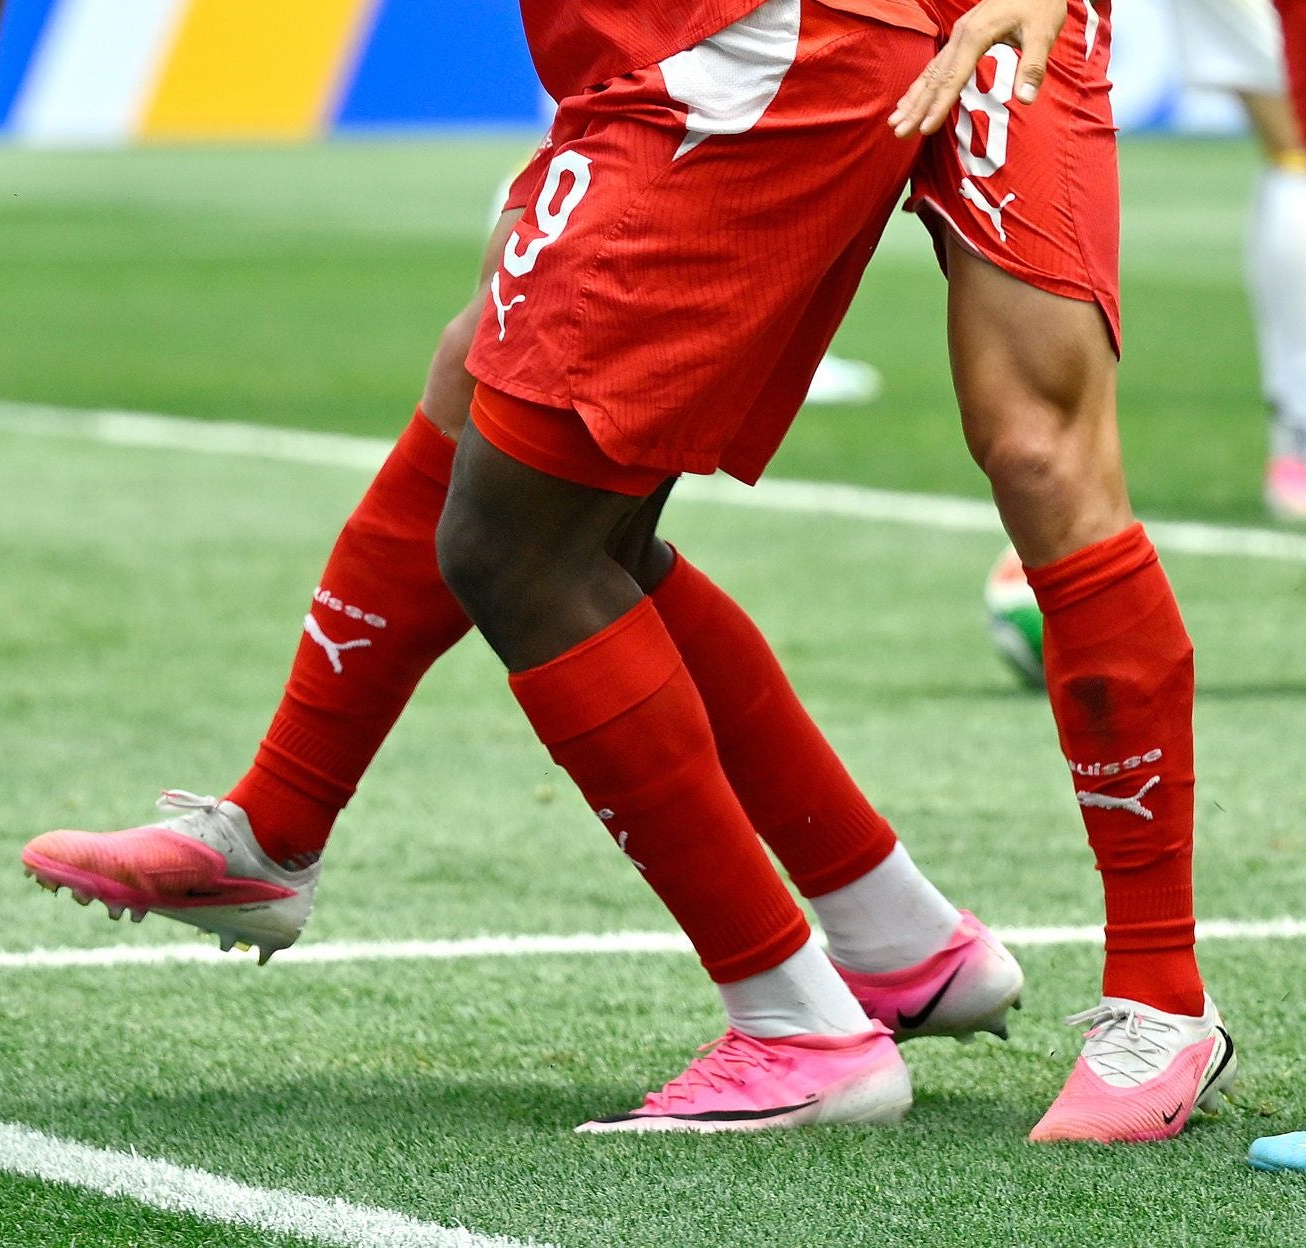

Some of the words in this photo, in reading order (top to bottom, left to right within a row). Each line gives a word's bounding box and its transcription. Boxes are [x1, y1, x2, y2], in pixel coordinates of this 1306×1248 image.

[955, 43, 1019, 178] 8
[503, 149, 593, 278] 9
[313, 586, 387, 629] uisse
